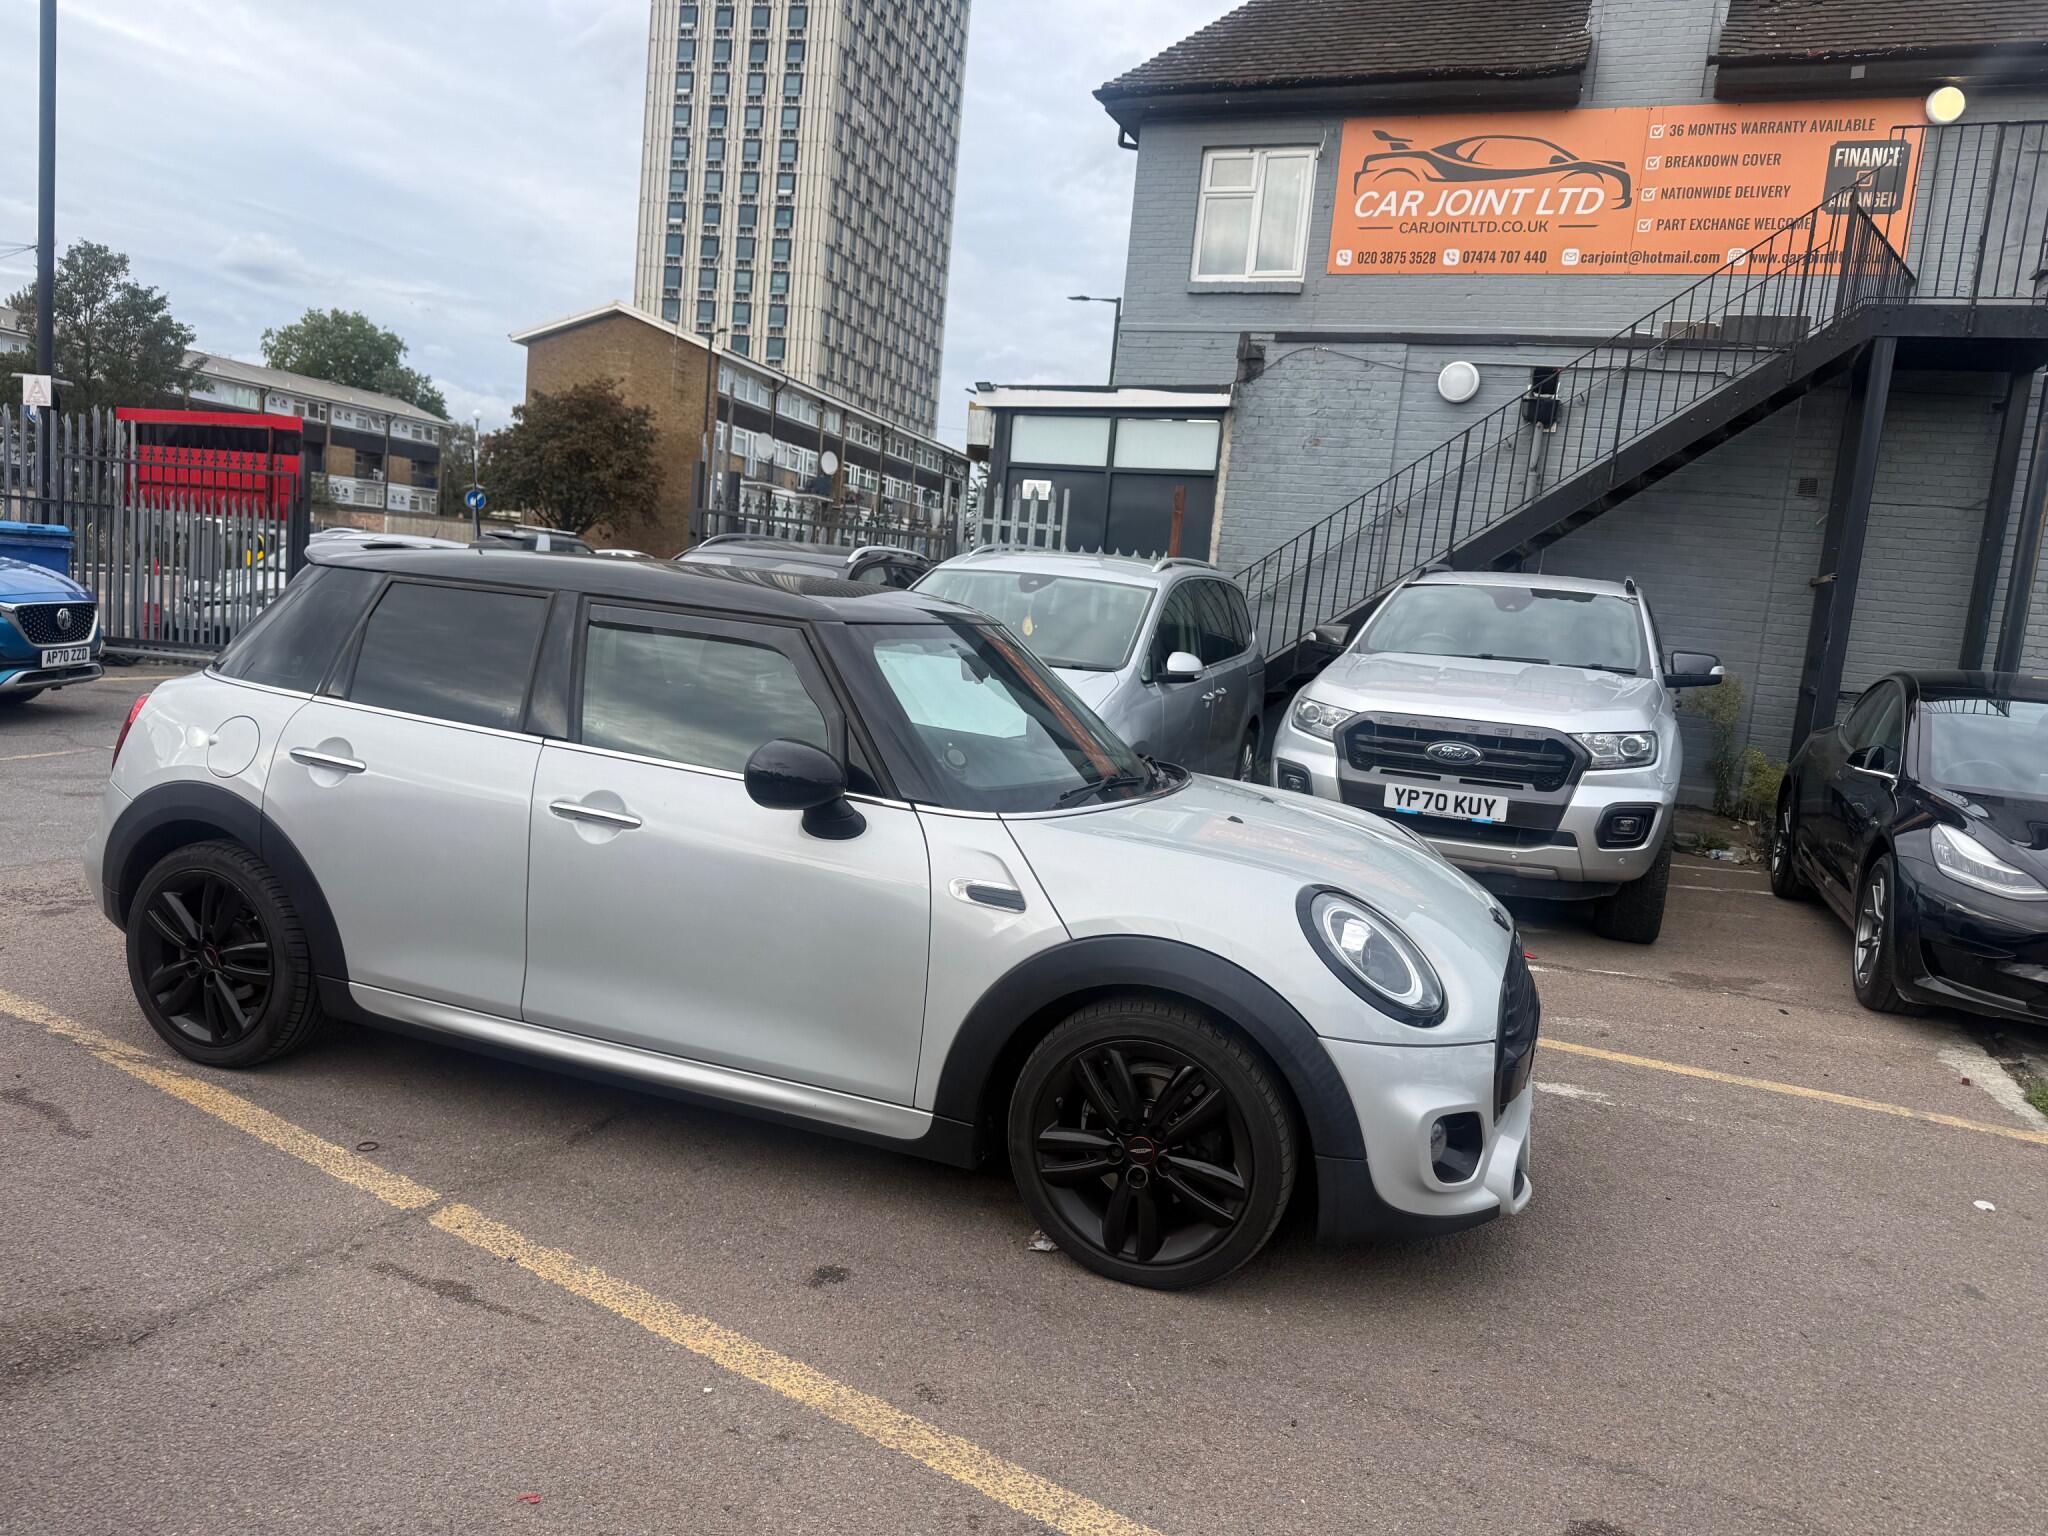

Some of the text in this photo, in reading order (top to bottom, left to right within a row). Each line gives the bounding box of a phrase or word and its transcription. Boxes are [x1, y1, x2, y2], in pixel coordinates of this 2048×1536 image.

[1669, 118, 1877, 137] 36 MONTHS WARRANTY AVAILABLE
[1664, 153, 1782, 168] BREAKDOWN COVER
[1834, 147, 1904, 168] FINANCE
[1660, 185, 1791, 200] NATIONWIDE DELIVERY
[1354, 187, 1605, 217] CAR JOINT LTD
[1399, 220, 1549, 234] CARJOINTLTD.CO.UK
[1656, 217, 1812, 231] PART EXCHANGE WELCOME
[1357, 251, 1436, 265] 020 3875 3528
[1462, 250, 1547, 264] 07474 707 440
[1580, 250, 1720, 266] carjoint@hotmail.com
[46, 650, 69, 664] AP70
[1437, 745, 1468, 760] Ford
[1395, 787, 1447, 812] YP70
[1454, 795, 1496, 817] KUY
